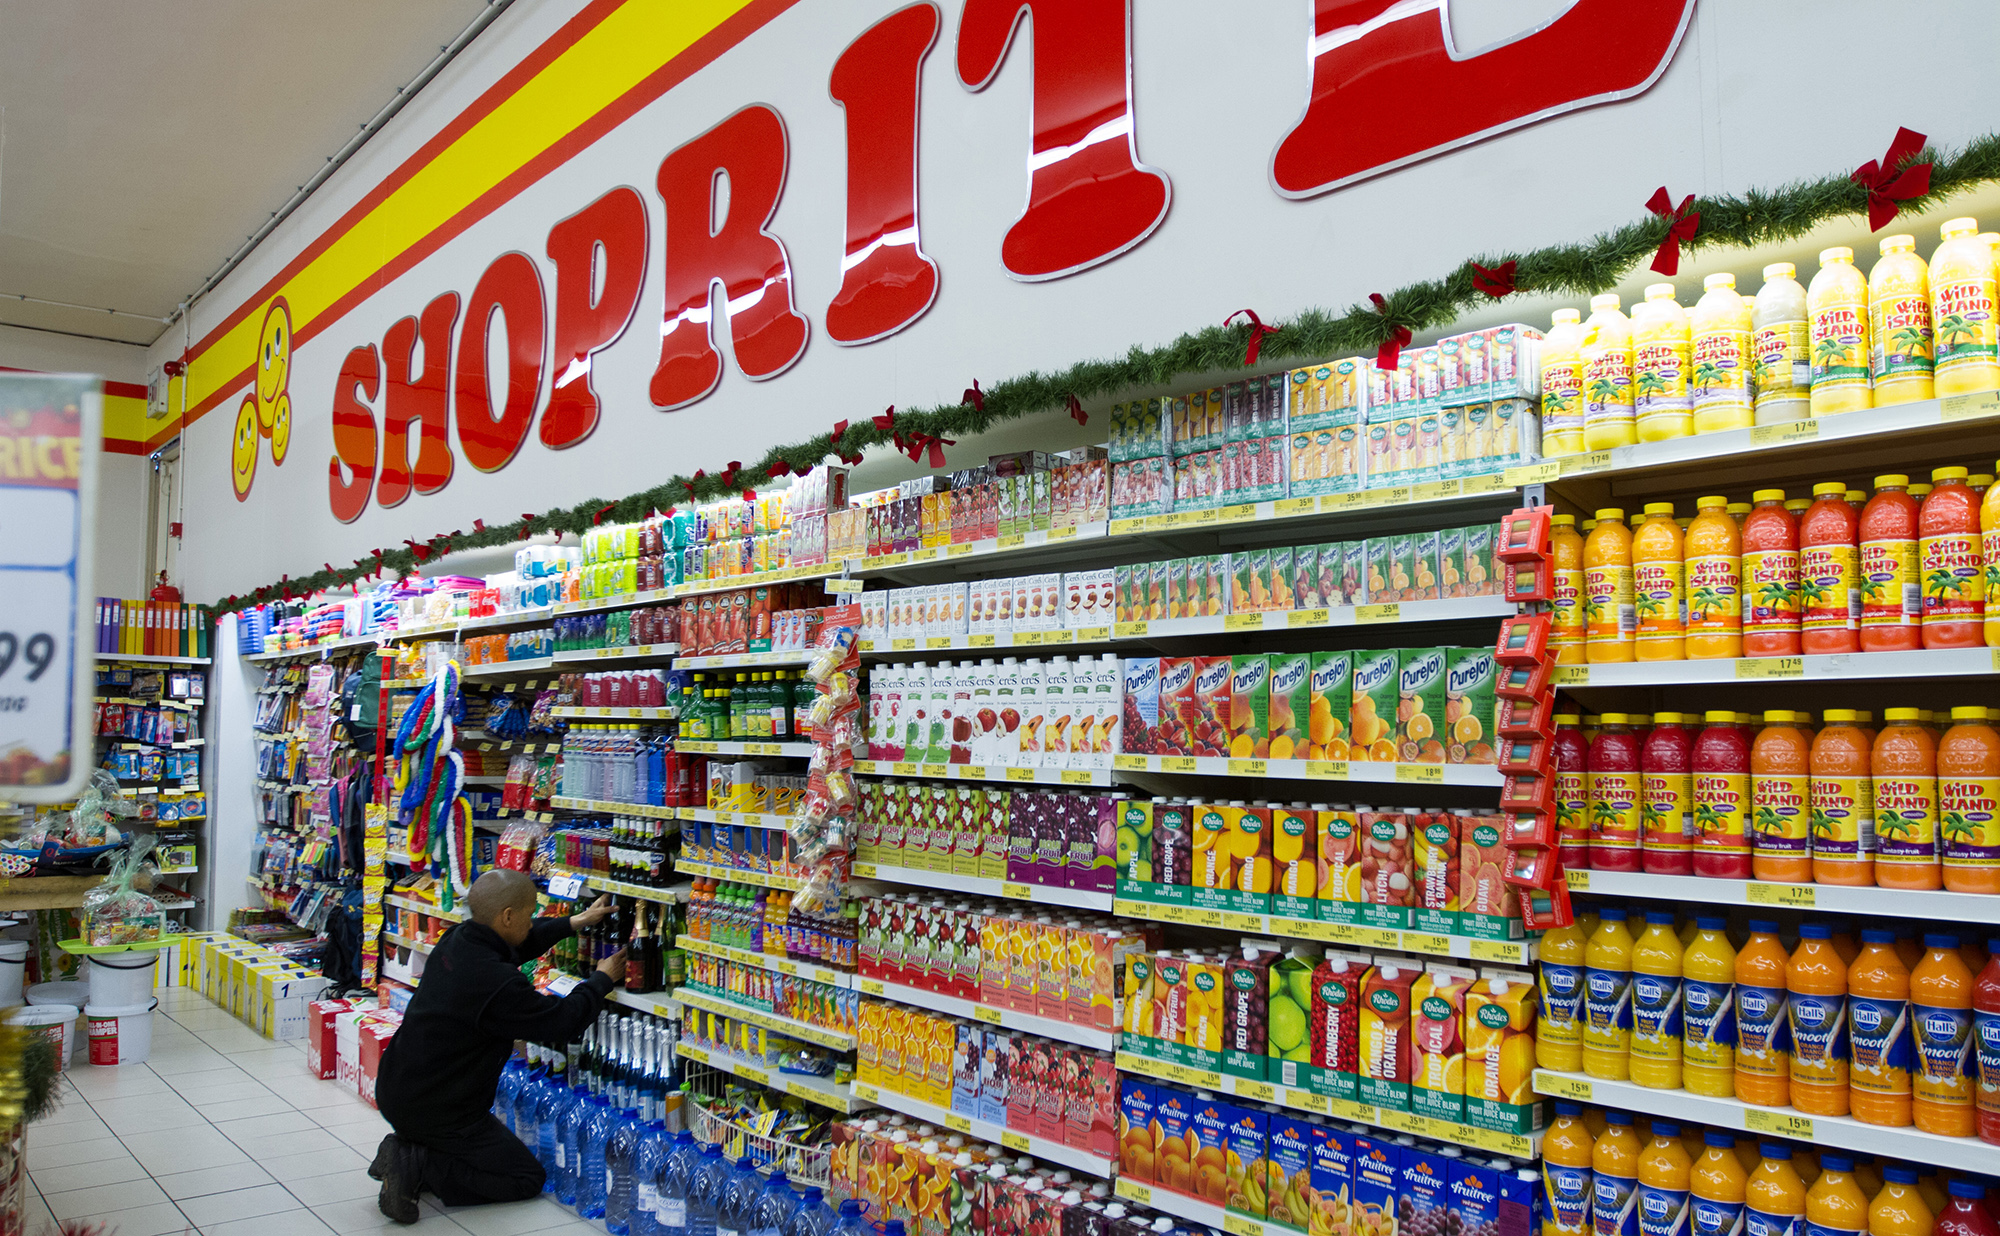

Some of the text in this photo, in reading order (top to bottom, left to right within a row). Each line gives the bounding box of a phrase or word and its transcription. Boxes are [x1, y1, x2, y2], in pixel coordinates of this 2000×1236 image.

[1164, 839, 1174, 883] RED GRAPE
[1206, 850, 1216, 886] ORANGE
[1244, 856, 1254, 890] MANGO
[1288, 860, 1298, 895] MANGO
[1333, 850, 1345, 899] TROPICAL
[1426, 846, 1439, 908] STRAWBERRY
[1378, 870, 1388, 903] LITCHI
[1436, 861, 1448, 897] BANANA
[1477, 879, 1489, 912] GUAVA
[1638, 985, 1661, 997] Hall's
[1687, 992, 1709, 1003] Hall's
[1742, 998, 1767, 1010] Hall's
[1237, 991, 1249, 1049] RED GRAPE
[1798, 1007, 1826, 1019] Hall's
[1855, 1010, 1881, 1022] Hall's
[1927, 1019, 1956, 1032] Hall's
[1198, 1016, 1208, 1048] PEACH
[1327, 1005, 1339, 1068] CRANBERRY
[1371, 1031, 1384, 1077] MANGO
[1384, 1028, 1398, 1079] ORANGE
[1429, 1025, 1443, 1087] TROPICAL
[1485, 1044, 1500, 1098] ORANGE
[323, 1070, 335, 1078] A4
